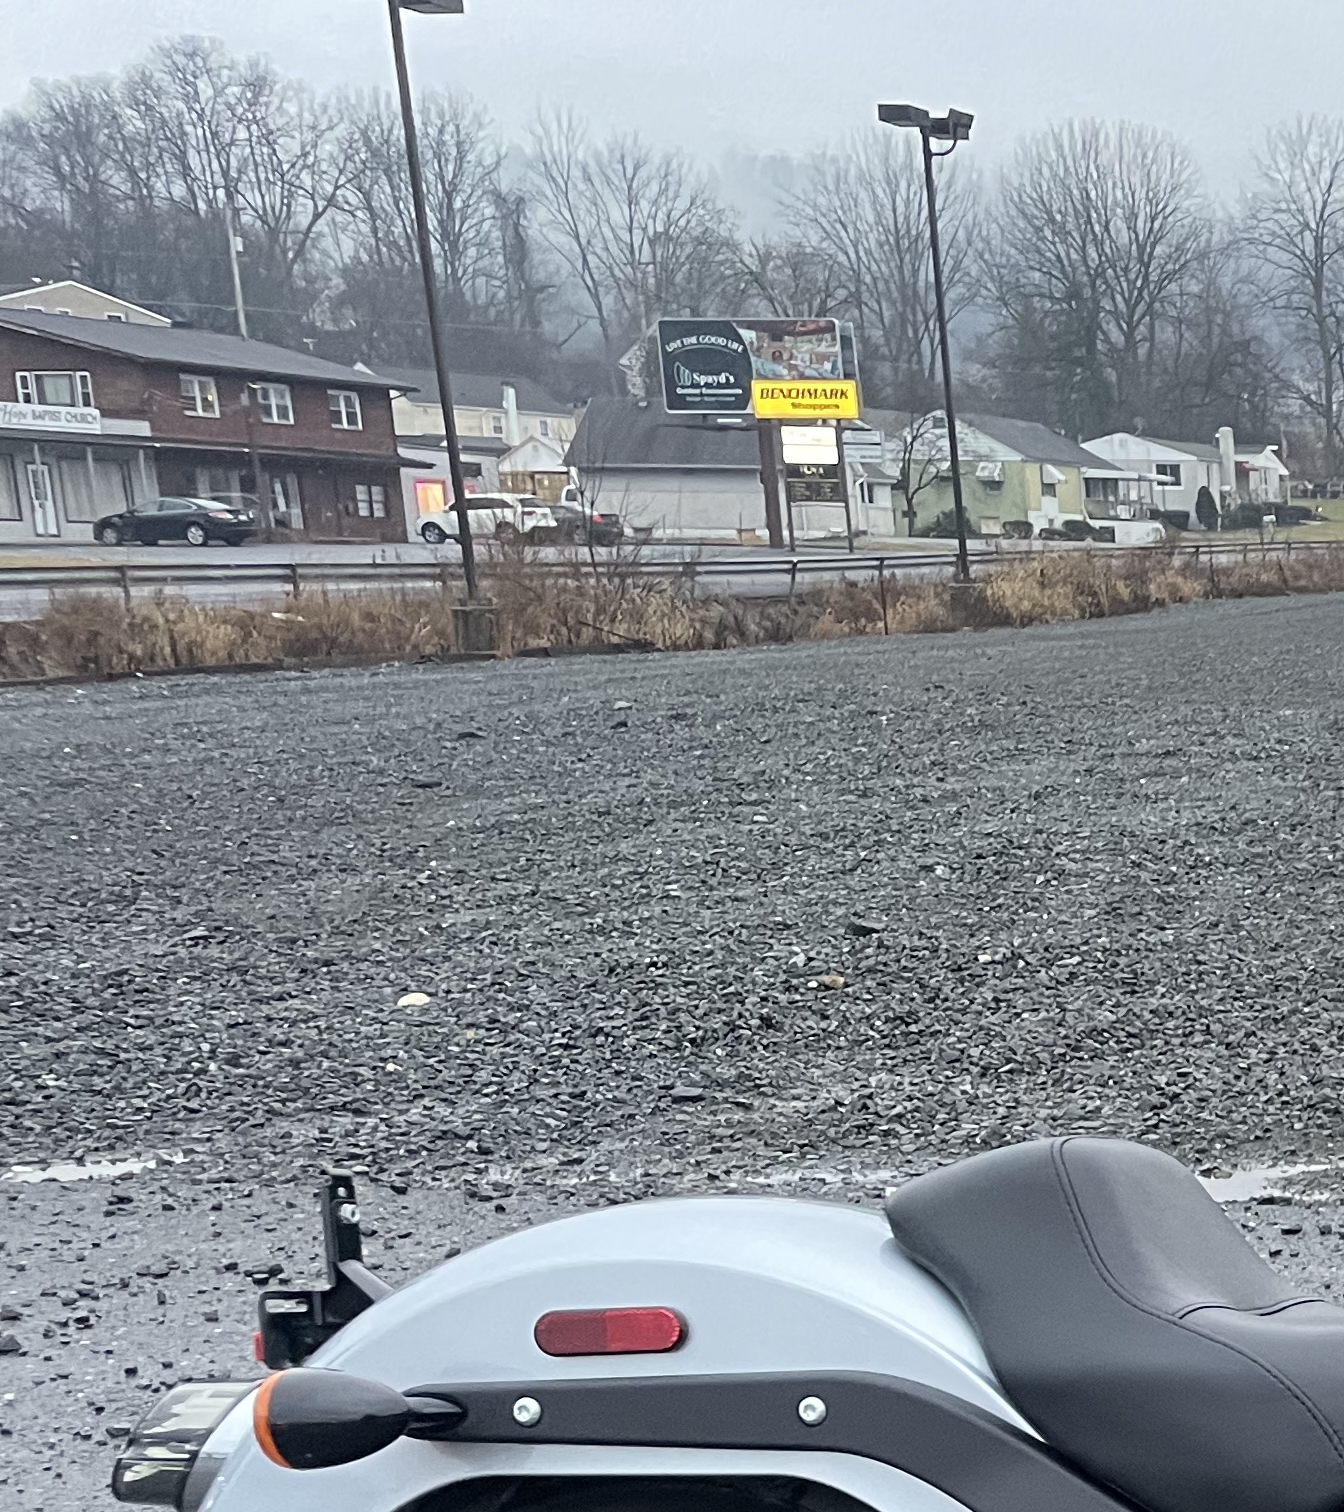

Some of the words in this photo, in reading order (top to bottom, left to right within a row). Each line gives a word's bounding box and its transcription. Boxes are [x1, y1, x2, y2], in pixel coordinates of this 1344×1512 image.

[699, 335, 727, 346] GOOD
[727, 339, 744, 353] LIFE
[760, 387, 849, 400] BENCHMARK
